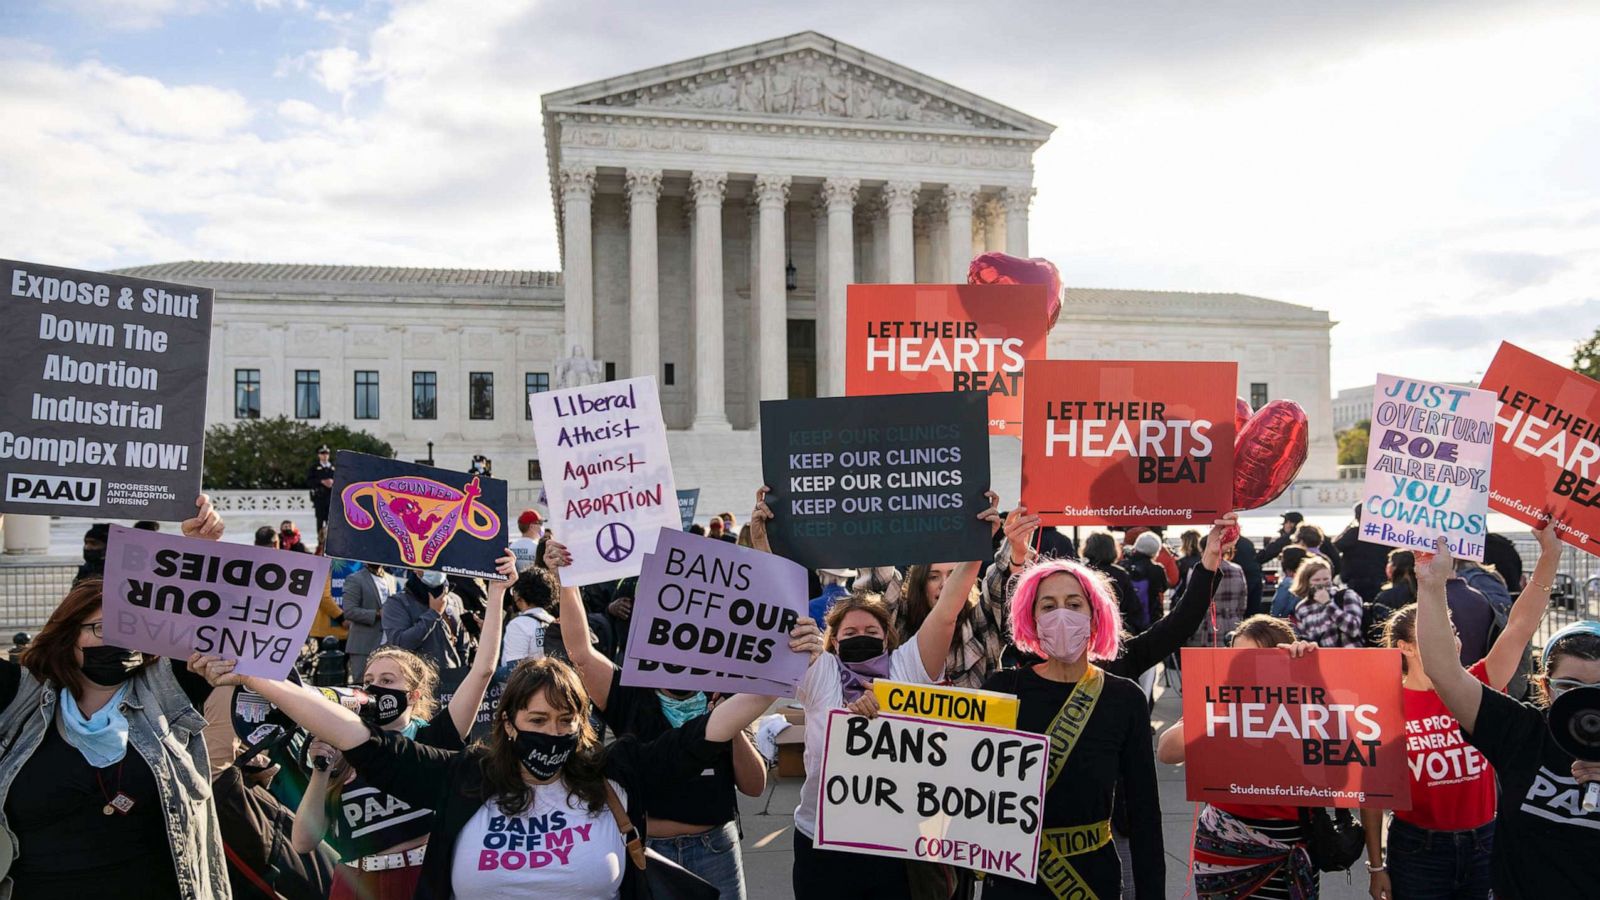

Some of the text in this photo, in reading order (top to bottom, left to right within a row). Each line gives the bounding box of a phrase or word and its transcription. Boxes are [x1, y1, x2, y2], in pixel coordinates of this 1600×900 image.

[11, 269, 199, 319] Expose & Shut
[39, 313, 168, 352] Down The
[867, 321, 978, 338] LET THEIR
[867, 337, 1025, 372] HEARTS
[43, 354, 158, 391] Abortion
[953, 371, 1024, 396] BEAT
[31, 393, 163, 429] Industrial
[1047, 401, 1166, 421] LET THEIR
[1384, 380, 1470, 412] JUST
[1498, 385, 1540, 415] LET
[557, 419, 639, 448] Atheist
[789, 424, 960, 447] KEEP OUR CLINICS
[1045, 419, 1213, 457] HEARTS
[1377, 401, 1493, 444] OVERTURN
[0, 431, 189, 470] Complex NOW!
[789, 447, 962, 470] KEEP OUR CLINICS
[1379, 429, 1459, 463] ROE
[1494, 400, 1600, 484] HEAR
[564, 453, 645, 489] Against
[790, 470, 963, 493] KEEP OUR CLINICS
[1138, 456, 1212, 484] BEAT
[1373, 454, 1488, 493] ALREADY,
[11, 477, 97, 502] PAAU
[106, 490, 176, 500] ANTI-ABORTION
[106, 497, 149, 506] UPRISING
[107, 482, 168, 493] PROGRESSIVE
[389, 481, 452, 500] COUNTER
[791, 493, 963, 515] KEEP OUR CLINICS
[1392, 475, 1452, 508] YOU
[1552, 468, 1600, 509] BEA
[792, 515, 964, 537] KEEP OUR CLINICS
[1064, 505, 1193, 519] StudentsforLifeAction.org
[1366, 495, 1487, 537] COWARDS!
[153, 549, 313, 597] BODIES
[665, 547, 752, 591] BANS
[126, 578, 303, 630] OFF OUR
[658, 584, 799, 635] OFF OUR
[195, 625, 293, 664] BANS
[648, 617, 776, 664] BODIES
[888, 688, 987, 722] CAUTION
[1206, 686, 1326, 704] LET THEIR
[1206, 703, 1382, 741] HEARTS
[1405, 715, 1459, 734] HE PRO-
[846, 716, 1044, 781] BANS OFF
[1303, 739, 1382, 767] BEAT
[1406, 729, 1464, 751] ENERAT
[826, 775, 1038, 834] OUR BODIES
[1230, 783, 1365, 801] StudentsforLifeAction.org
[1525, 774, 1597, 816] PA
[343, 794, 411, 828] PAA
[488, 811, 567, 835] BANS
[483, 823, 593, 851] OFF MY
[1047, 828, 1100, 855] TION
[478, 845, 574, 871] BODY
[915, 836, 1025, 878] CODEPINK
